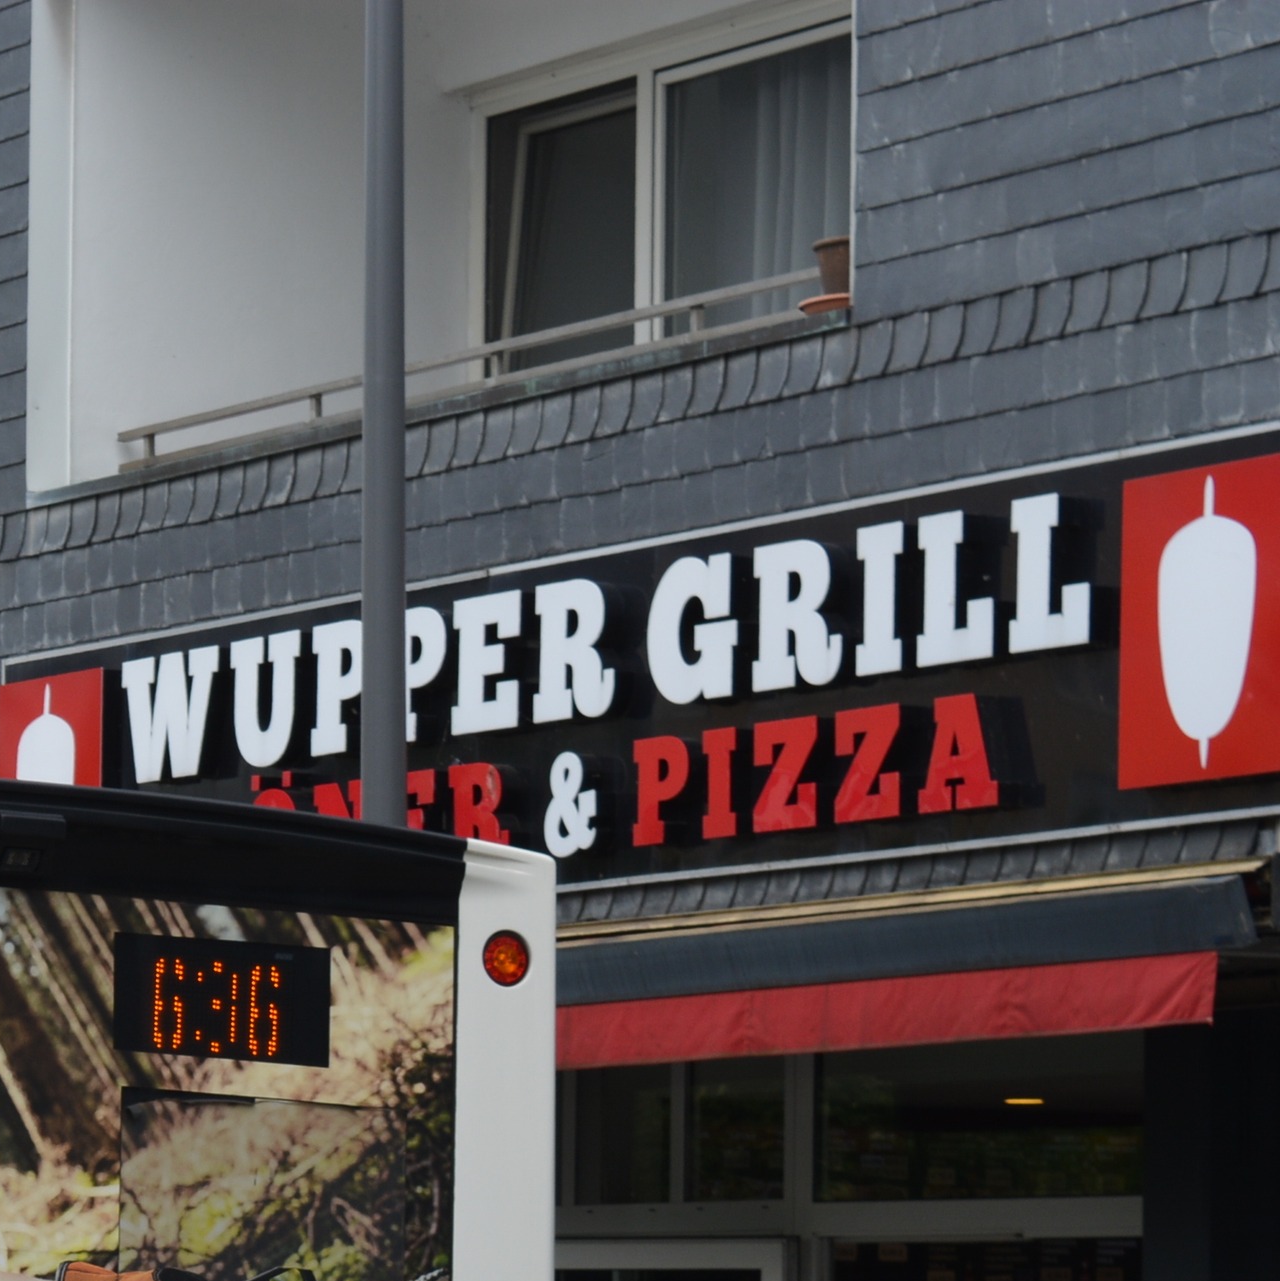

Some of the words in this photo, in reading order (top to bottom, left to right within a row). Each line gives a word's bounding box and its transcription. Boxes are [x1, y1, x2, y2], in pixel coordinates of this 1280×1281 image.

[122, 578, 615, 783] WUPPER
[647, 493, 1090, 704] GRILL
[544, 751, 597, 857] &
[633, 693, 998, 846] PIZZA
[153, 957, 280, 1056] 636
